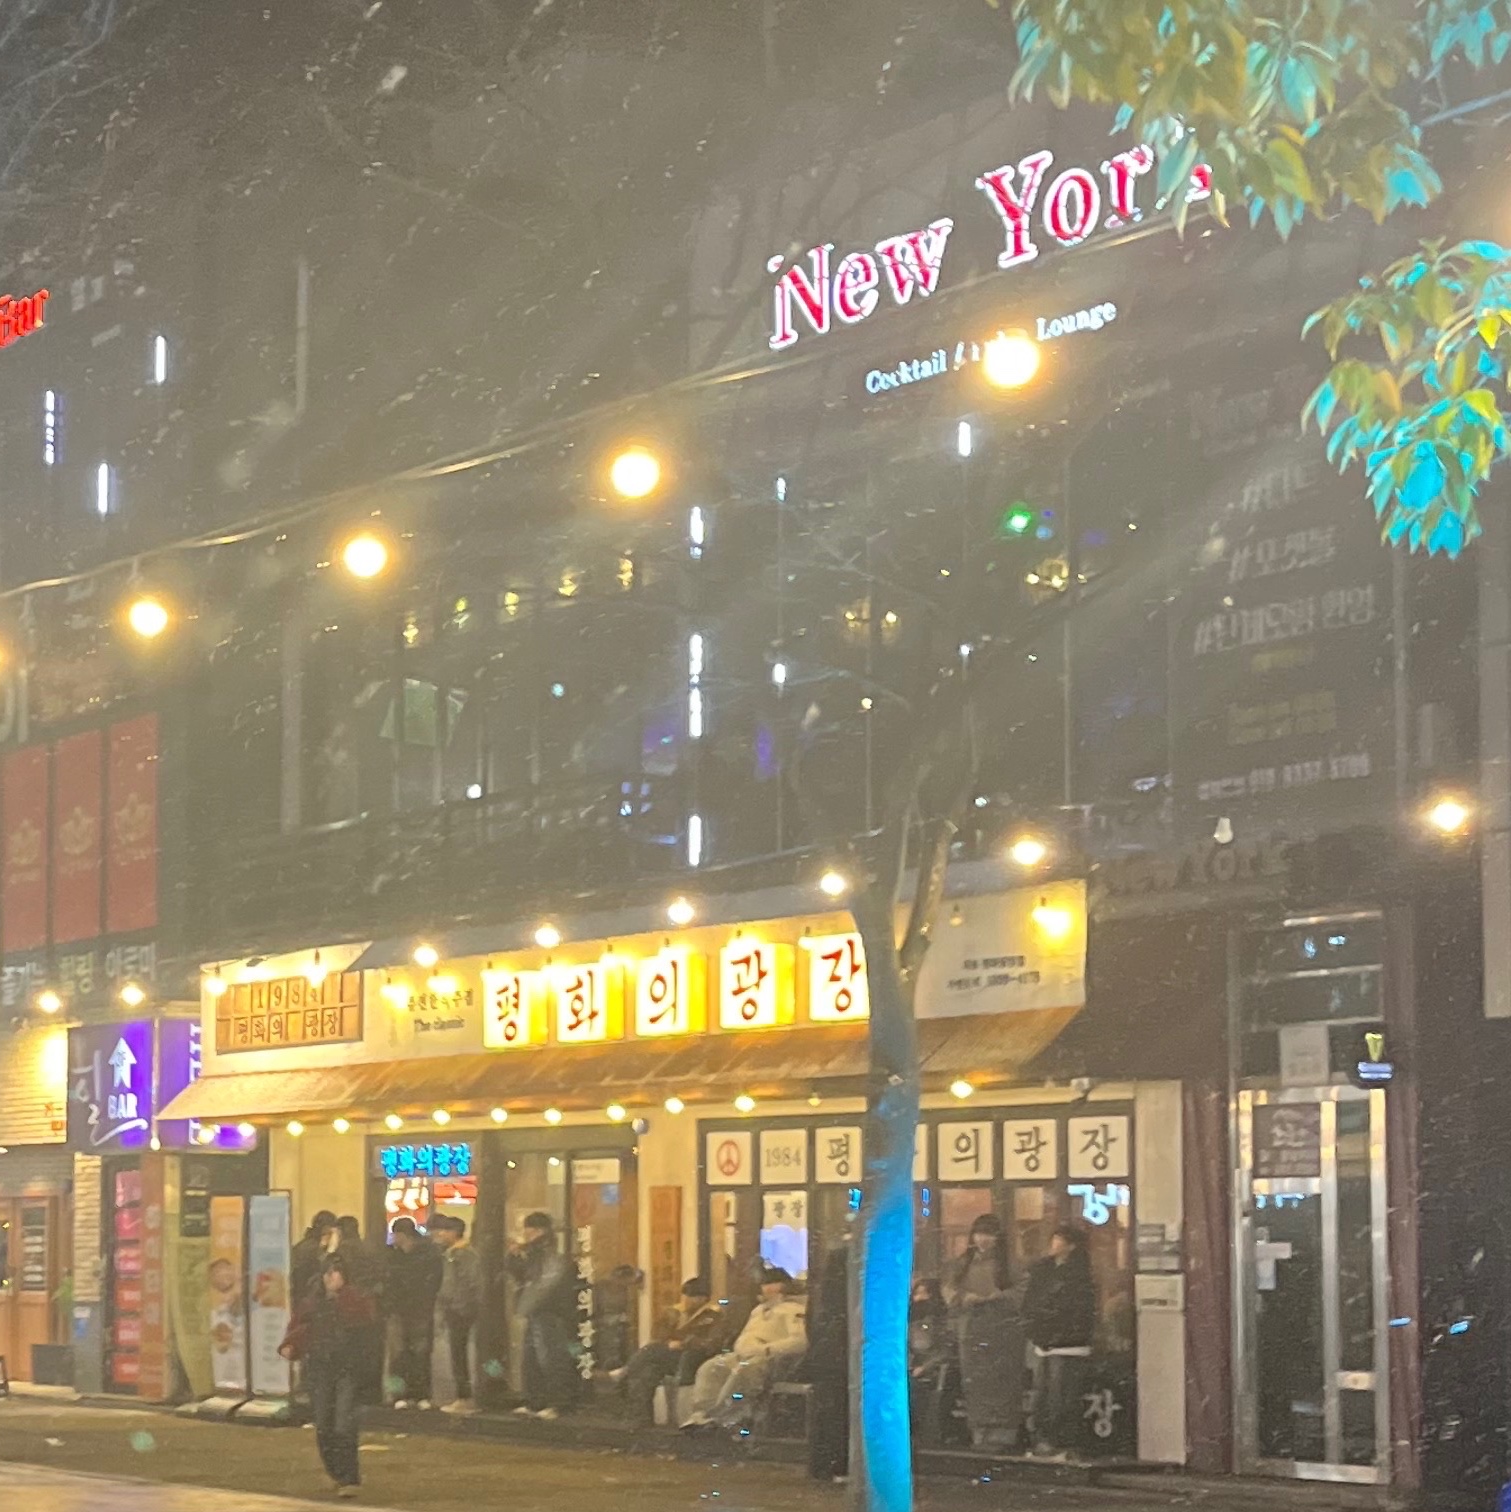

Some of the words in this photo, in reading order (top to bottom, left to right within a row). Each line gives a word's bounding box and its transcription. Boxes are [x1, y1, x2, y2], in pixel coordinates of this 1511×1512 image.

[769, 242, 955, 350] New
[975, 150, 1214, 268] Yor
[865, 348, 948, 394] Cocktail
[1036, 300, 1118, 341] Lounge
[494, 937, 864, 1042] 평화의광장
[108, 1092, 138, 1119] BAR
[765, 1147, 802, 1168] 1984
